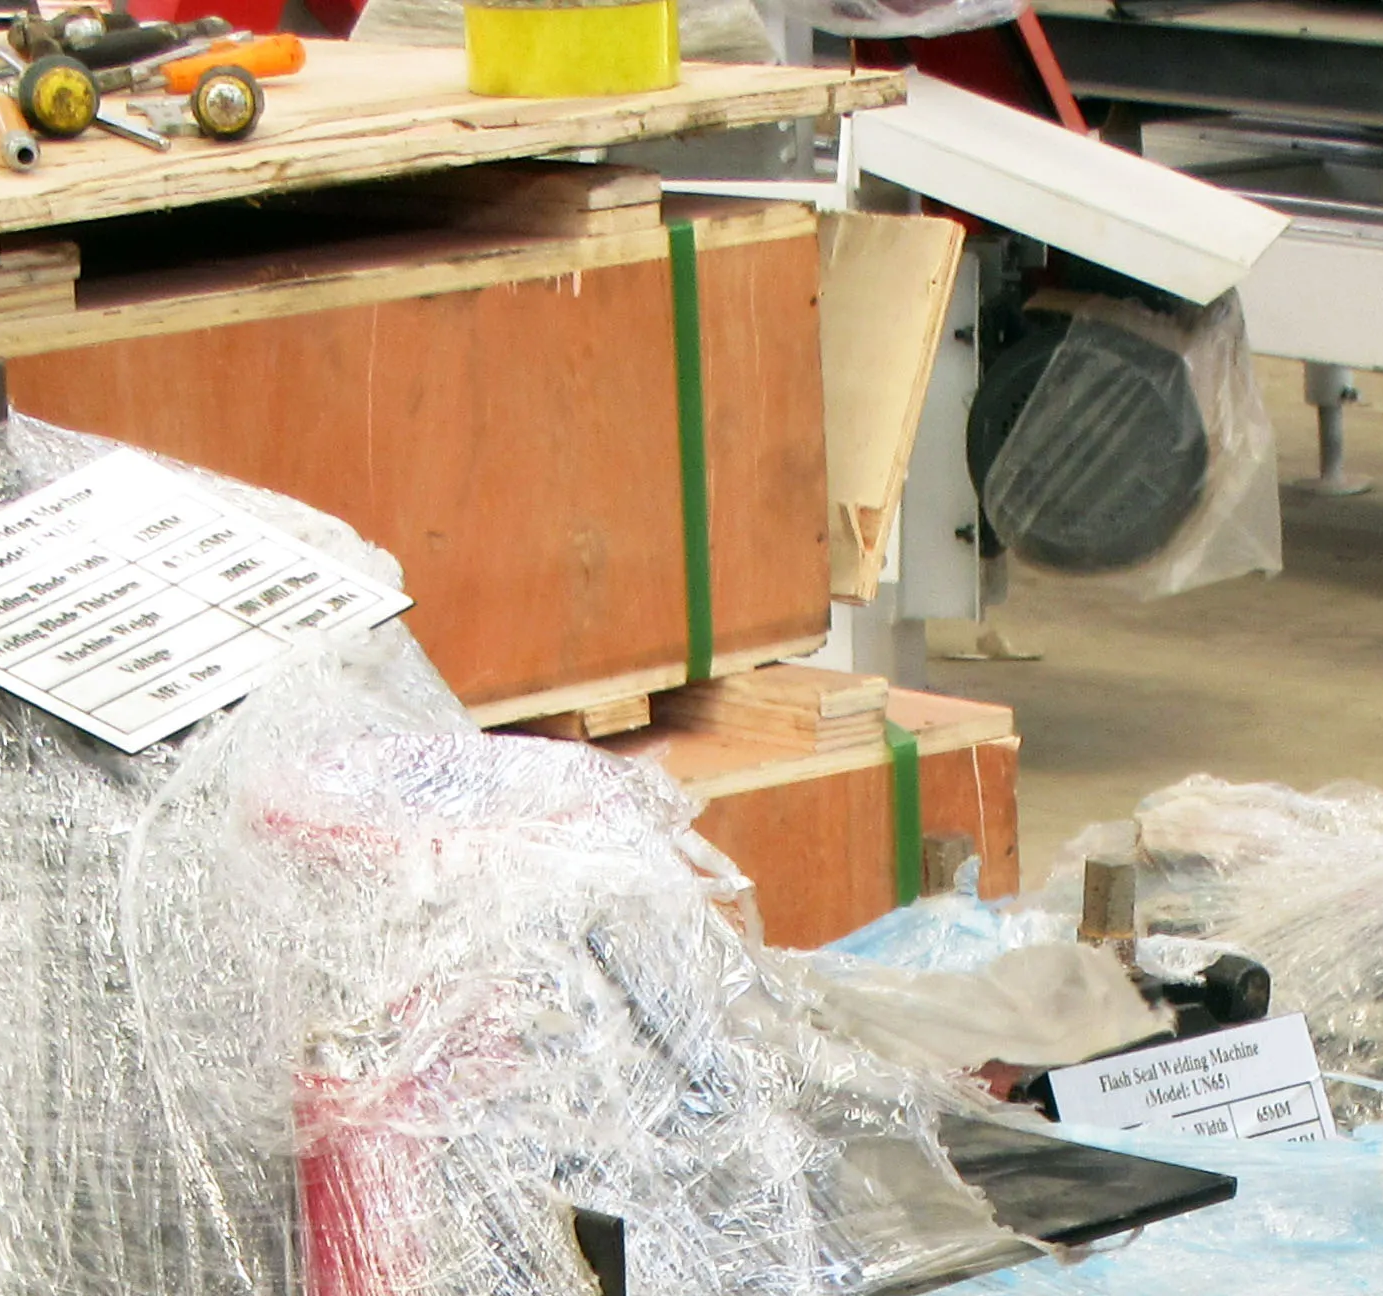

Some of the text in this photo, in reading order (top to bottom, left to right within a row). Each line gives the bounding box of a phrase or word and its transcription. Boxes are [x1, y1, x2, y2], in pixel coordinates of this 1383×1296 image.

[32, 487, 93, 516] Machine
[26, 576, 68, 596] Blade
[64, 554, 109, 575] Width
[37, 611, 80, 633] Blade
[75, 581, 140, 612] Thickness
[55, 611, 162, 663] Machine Weight
[117, 649, 173, 675] Voltage
[1099, 1041, 1260, 1094] Flash Seal Welding Machine
[1145, 1074, 1230, 1108] (Model: UN65)
[1194, 1117, 1229, 1136] Width
[1256, 1100, 1293, 1123] 65MM
